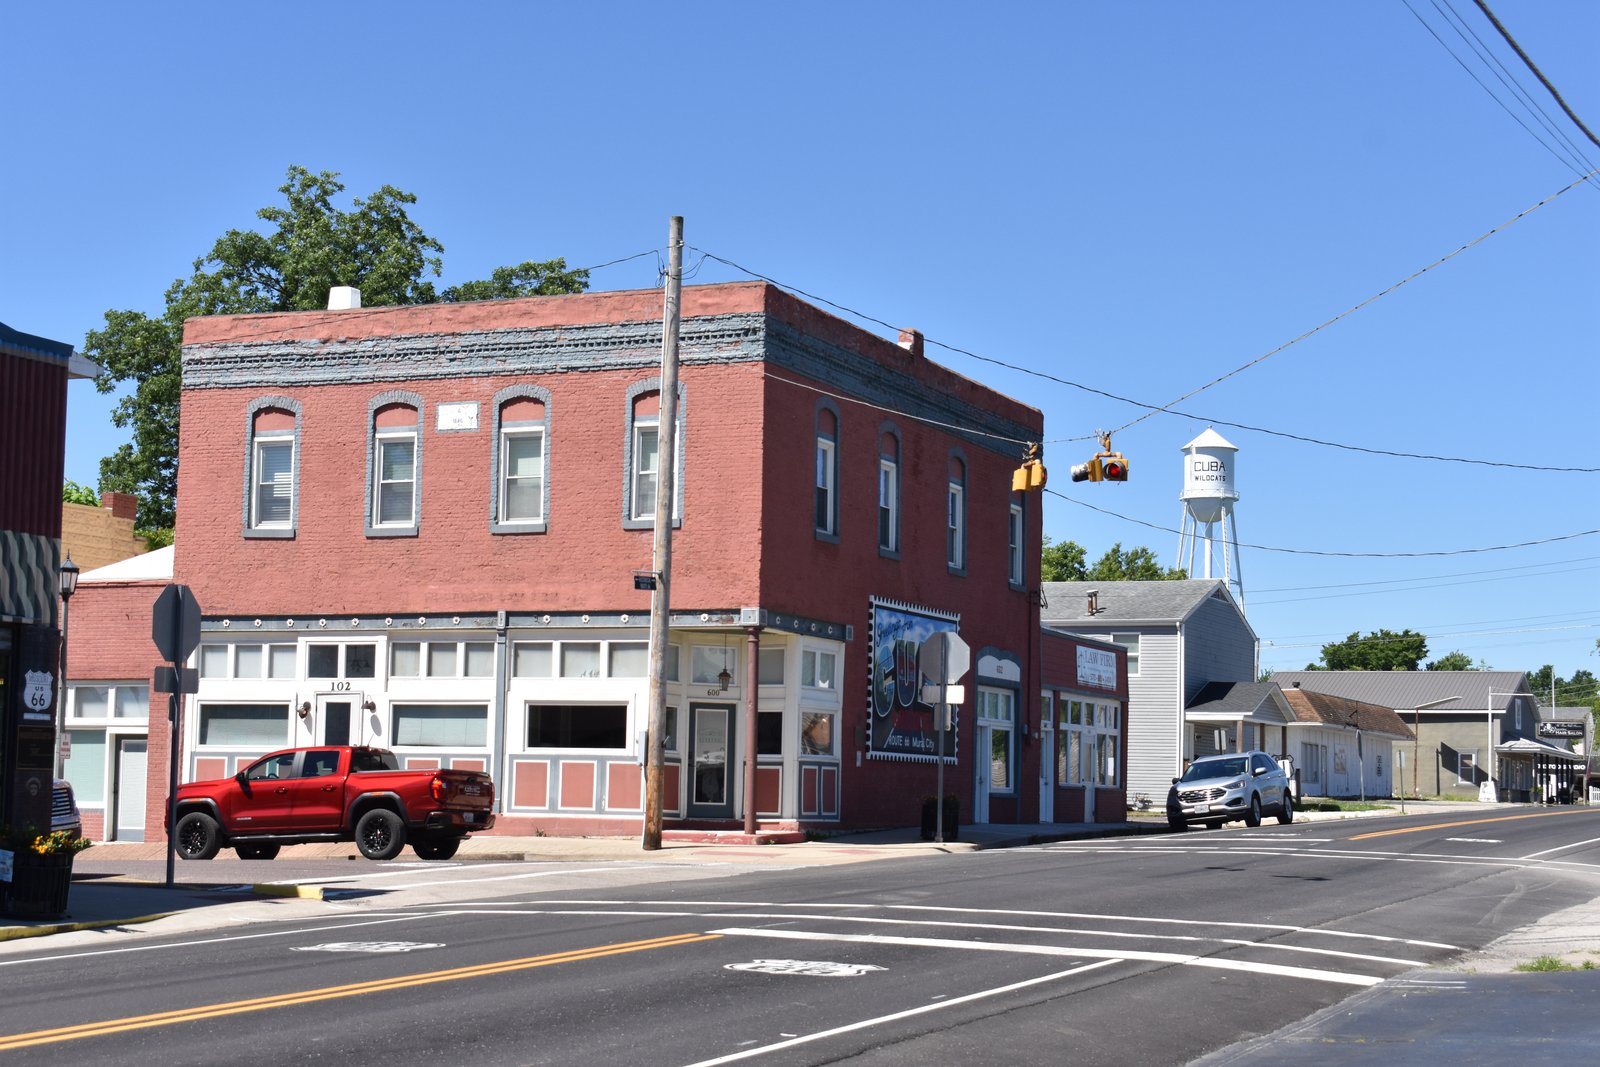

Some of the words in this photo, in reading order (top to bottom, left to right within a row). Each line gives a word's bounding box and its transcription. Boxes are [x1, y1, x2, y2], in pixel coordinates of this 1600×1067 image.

[1194, 461, 1226, 472] CUBA
[1194, 474, 1226, 482] WILDCATS
[1084, 650, 1099, 665] LAW
[331, 682, 351, 691] 102
[31, 692, 45, 706] 66
[888, 735, 903, 746] ROUTE
